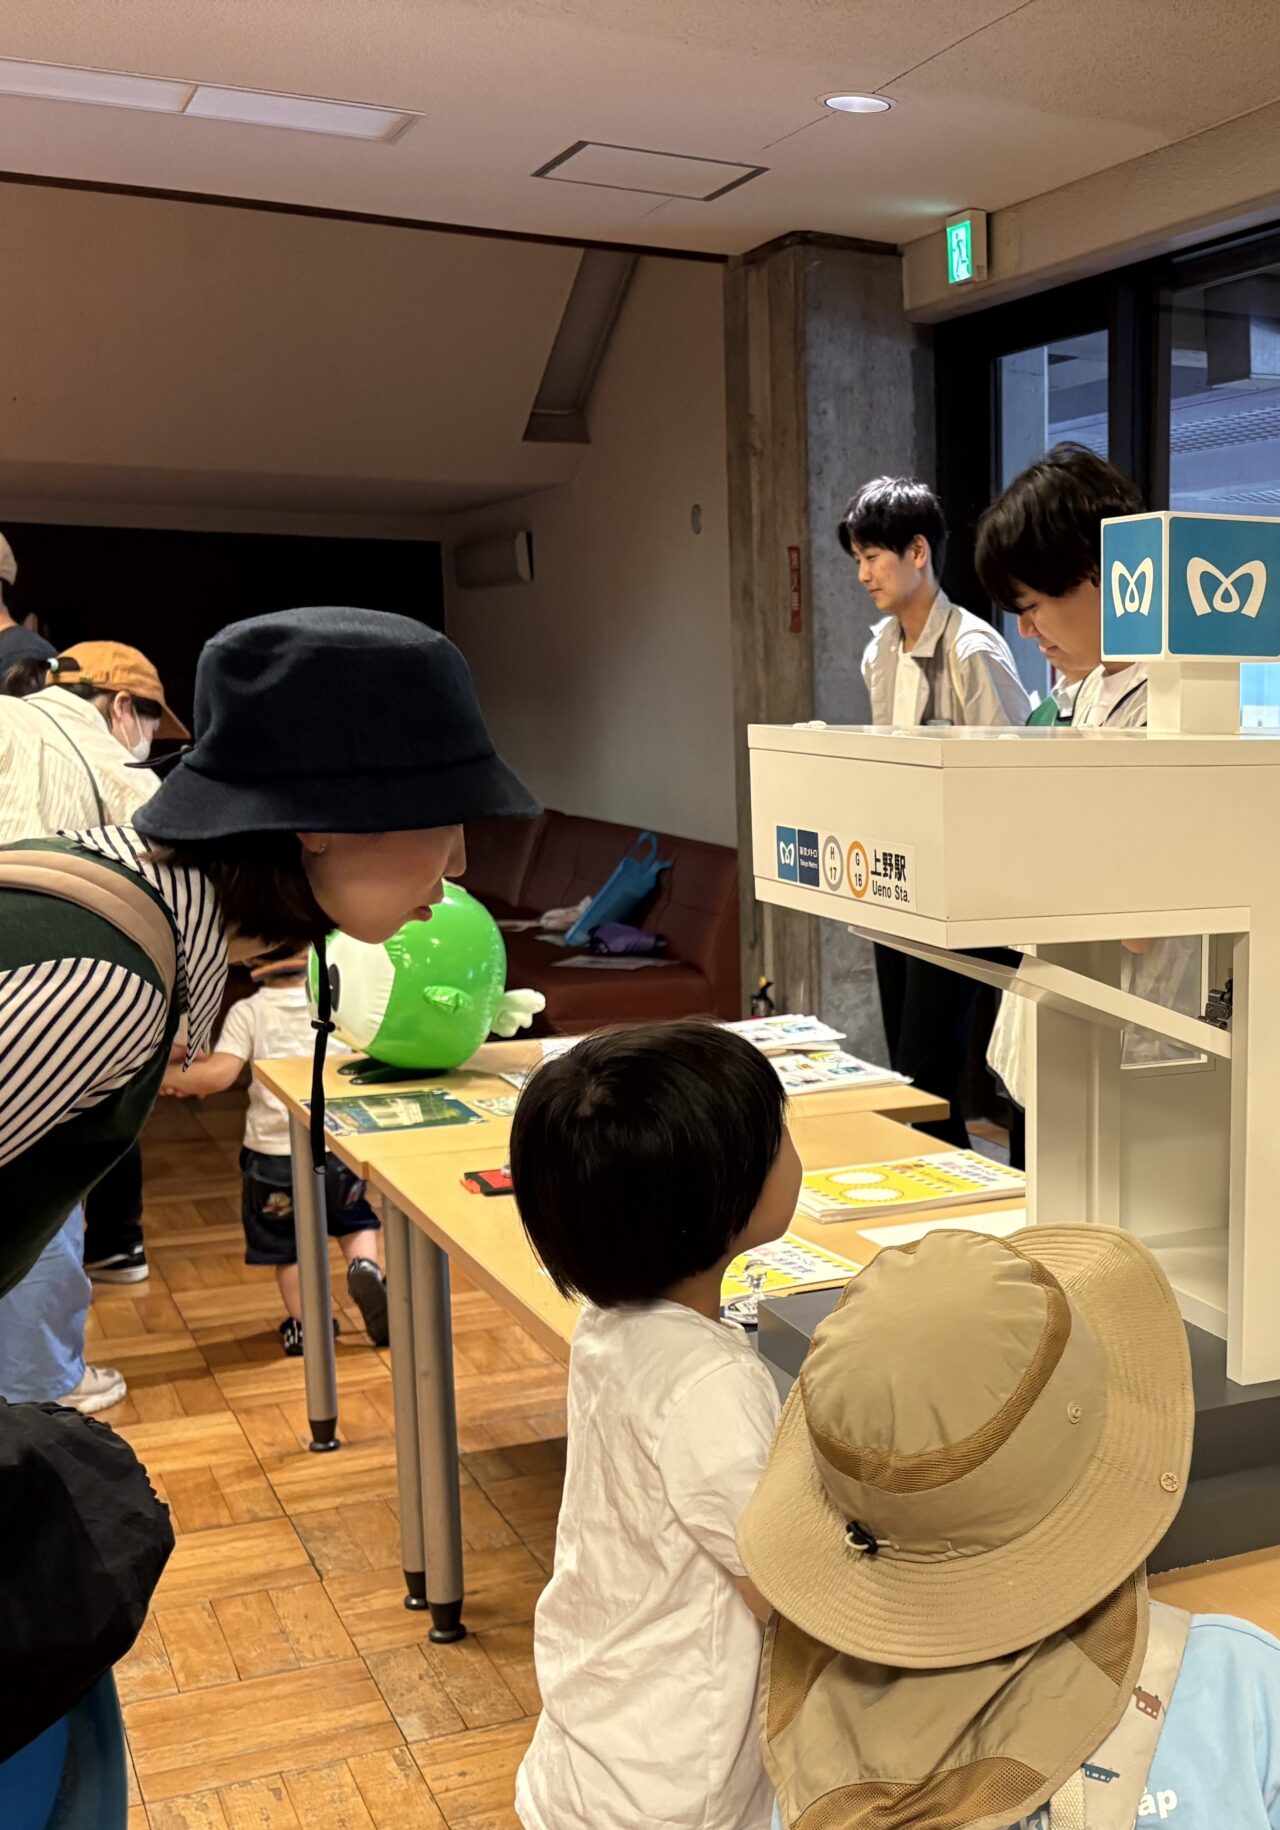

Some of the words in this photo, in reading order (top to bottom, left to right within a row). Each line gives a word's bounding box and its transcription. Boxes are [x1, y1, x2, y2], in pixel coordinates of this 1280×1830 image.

[830, 846, 835, 860] H
[855, 852, 860, 866] G
[870, 848, 907, 883] 上野駅
[829, 866, 837, 881] 17
[854, 873, 863, 888] 16
[872, 879, 892, 899] Ueno
[894, 884, 910, 903] Sta.
